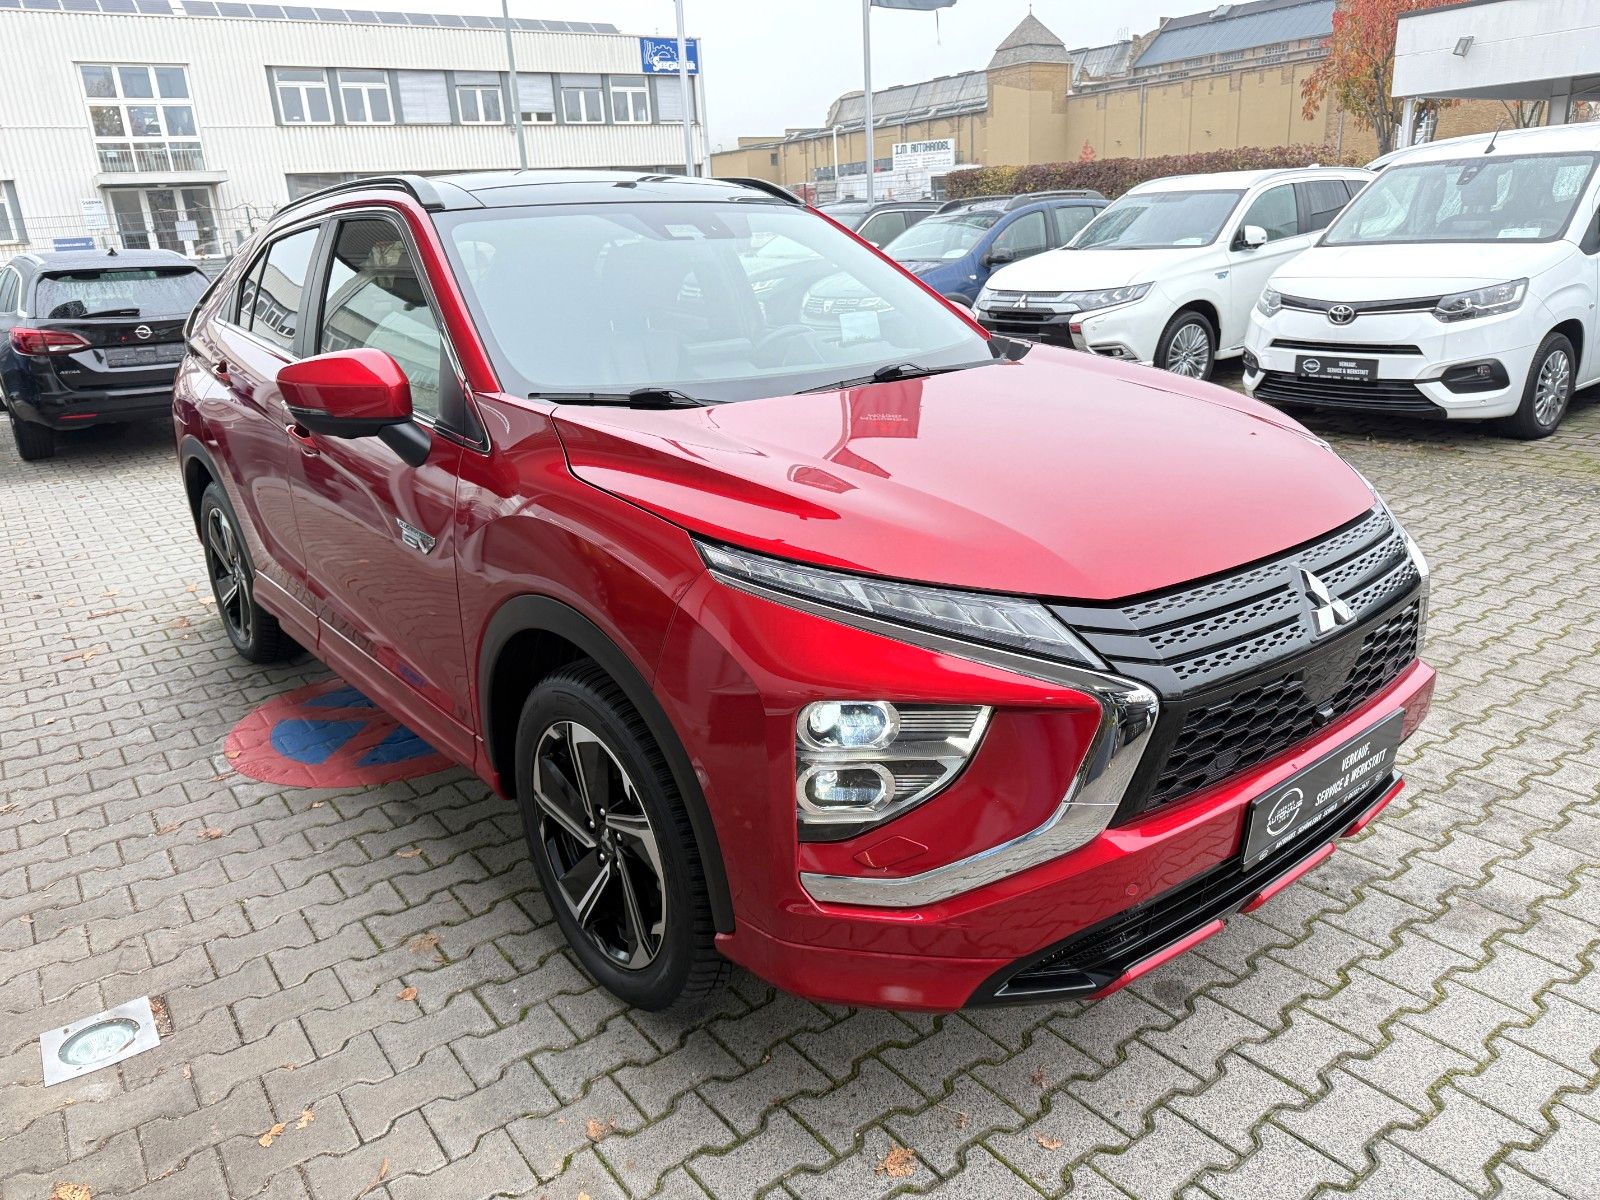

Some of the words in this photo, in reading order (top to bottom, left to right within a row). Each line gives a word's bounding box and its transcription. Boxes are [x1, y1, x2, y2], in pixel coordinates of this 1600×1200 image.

[911, 141, 951, 153] AUTOHANDEL
[1342, 742, 1370, 772] VERKAUF,
[1315, 777, 1344, 807] SERVICE
[1343, 774, 1350, 788] &
[1350, 748, 1388, 782] WERKSTATT
